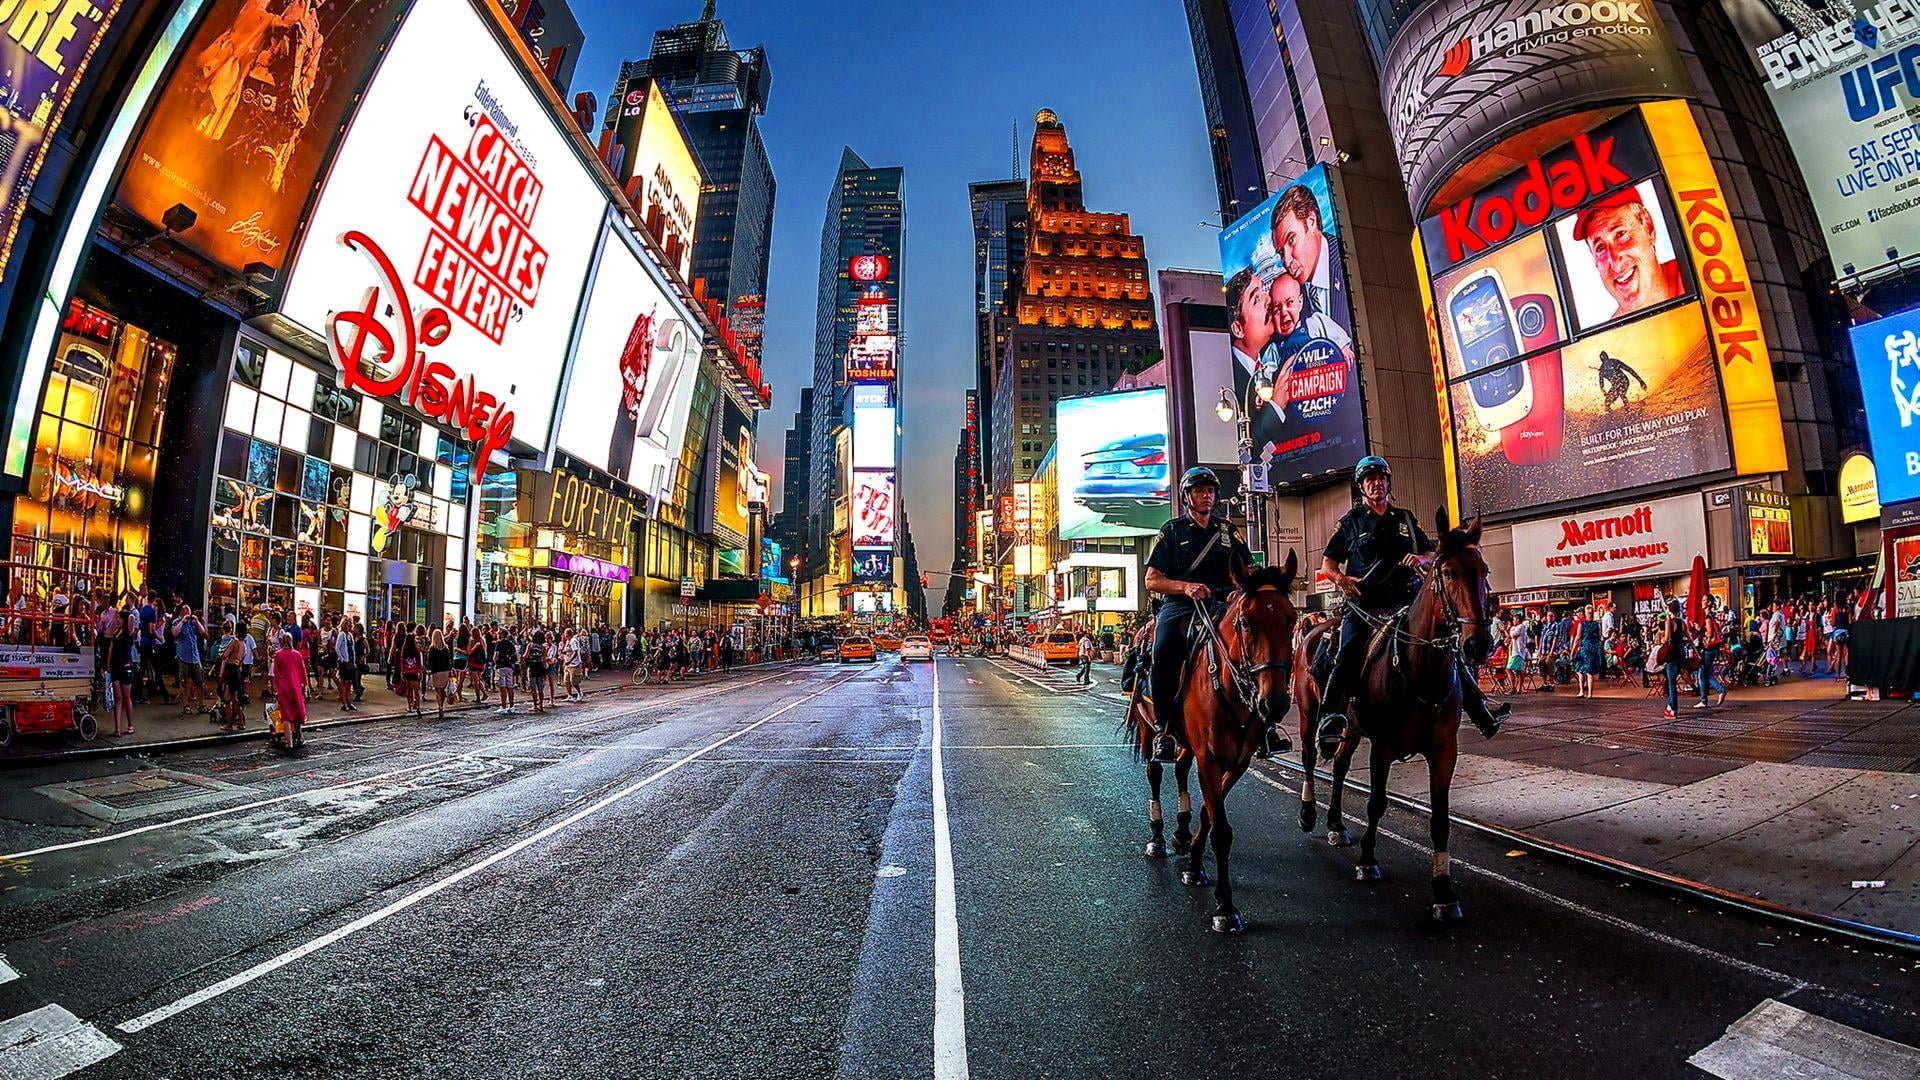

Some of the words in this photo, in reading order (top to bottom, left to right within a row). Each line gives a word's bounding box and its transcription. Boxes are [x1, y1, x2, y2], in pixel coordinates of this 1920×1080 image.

[1505, 29, 1569, 57] driving
[1572, 23, 1652, 38] emotion
[1756, 43, 1773, 58] JON
[1772, 31, 1798, 49] JONES
[1761, 18, 1863, 90] BONES
[474, 78, 519, 138] Entertainment
[624, 106, 641, 117] LG
[1848, 140, 1884, 169] SAT.
[1836, 167, 1878, 197] LIVE
[1876, 157, 1903, 183] ON
[654, 162, 673, 199] AND
[673, 193, 693, 233] ONLY
[1439, 133, 1631, 263] Kodak
[410, 140, 547, 303] NEWSIES
[1831, 218, 1861, 234] UFC.COM
[1678, 188, 1760, 367] Kodak
[848, 369, 895, 378] TOSHIBA
[1303, 349, 1329, 364] WILL
[1291, 370, 1343, 399] CAMPAIGN
[1427, 304, 1450, 445] Kodak
[1302, 396, 1332, 413] ZACH
[1580, 434, 1603, 447] BUILT
[1605, 430, 1622, 441] FOR
[1623, 424, 1641, 436] THE
[1641, 419, 1664, 432] WAY
[1665, 414, 1684, 426] YOU
[1685, 407, 1709, 421] PLAY.
[1745, 490, 1790, 506] MARQUIS
[1846, 480, 1875, 496] Marriott
[549, 469, 635, 546] FOREVER
[1556, 506, 1652, 550] Marriott
[1546, 555, 1571, 568] NEW
[1574, 550, 1607, 565] YORK
[1609, 542, 1669, 560] MARQUIS
